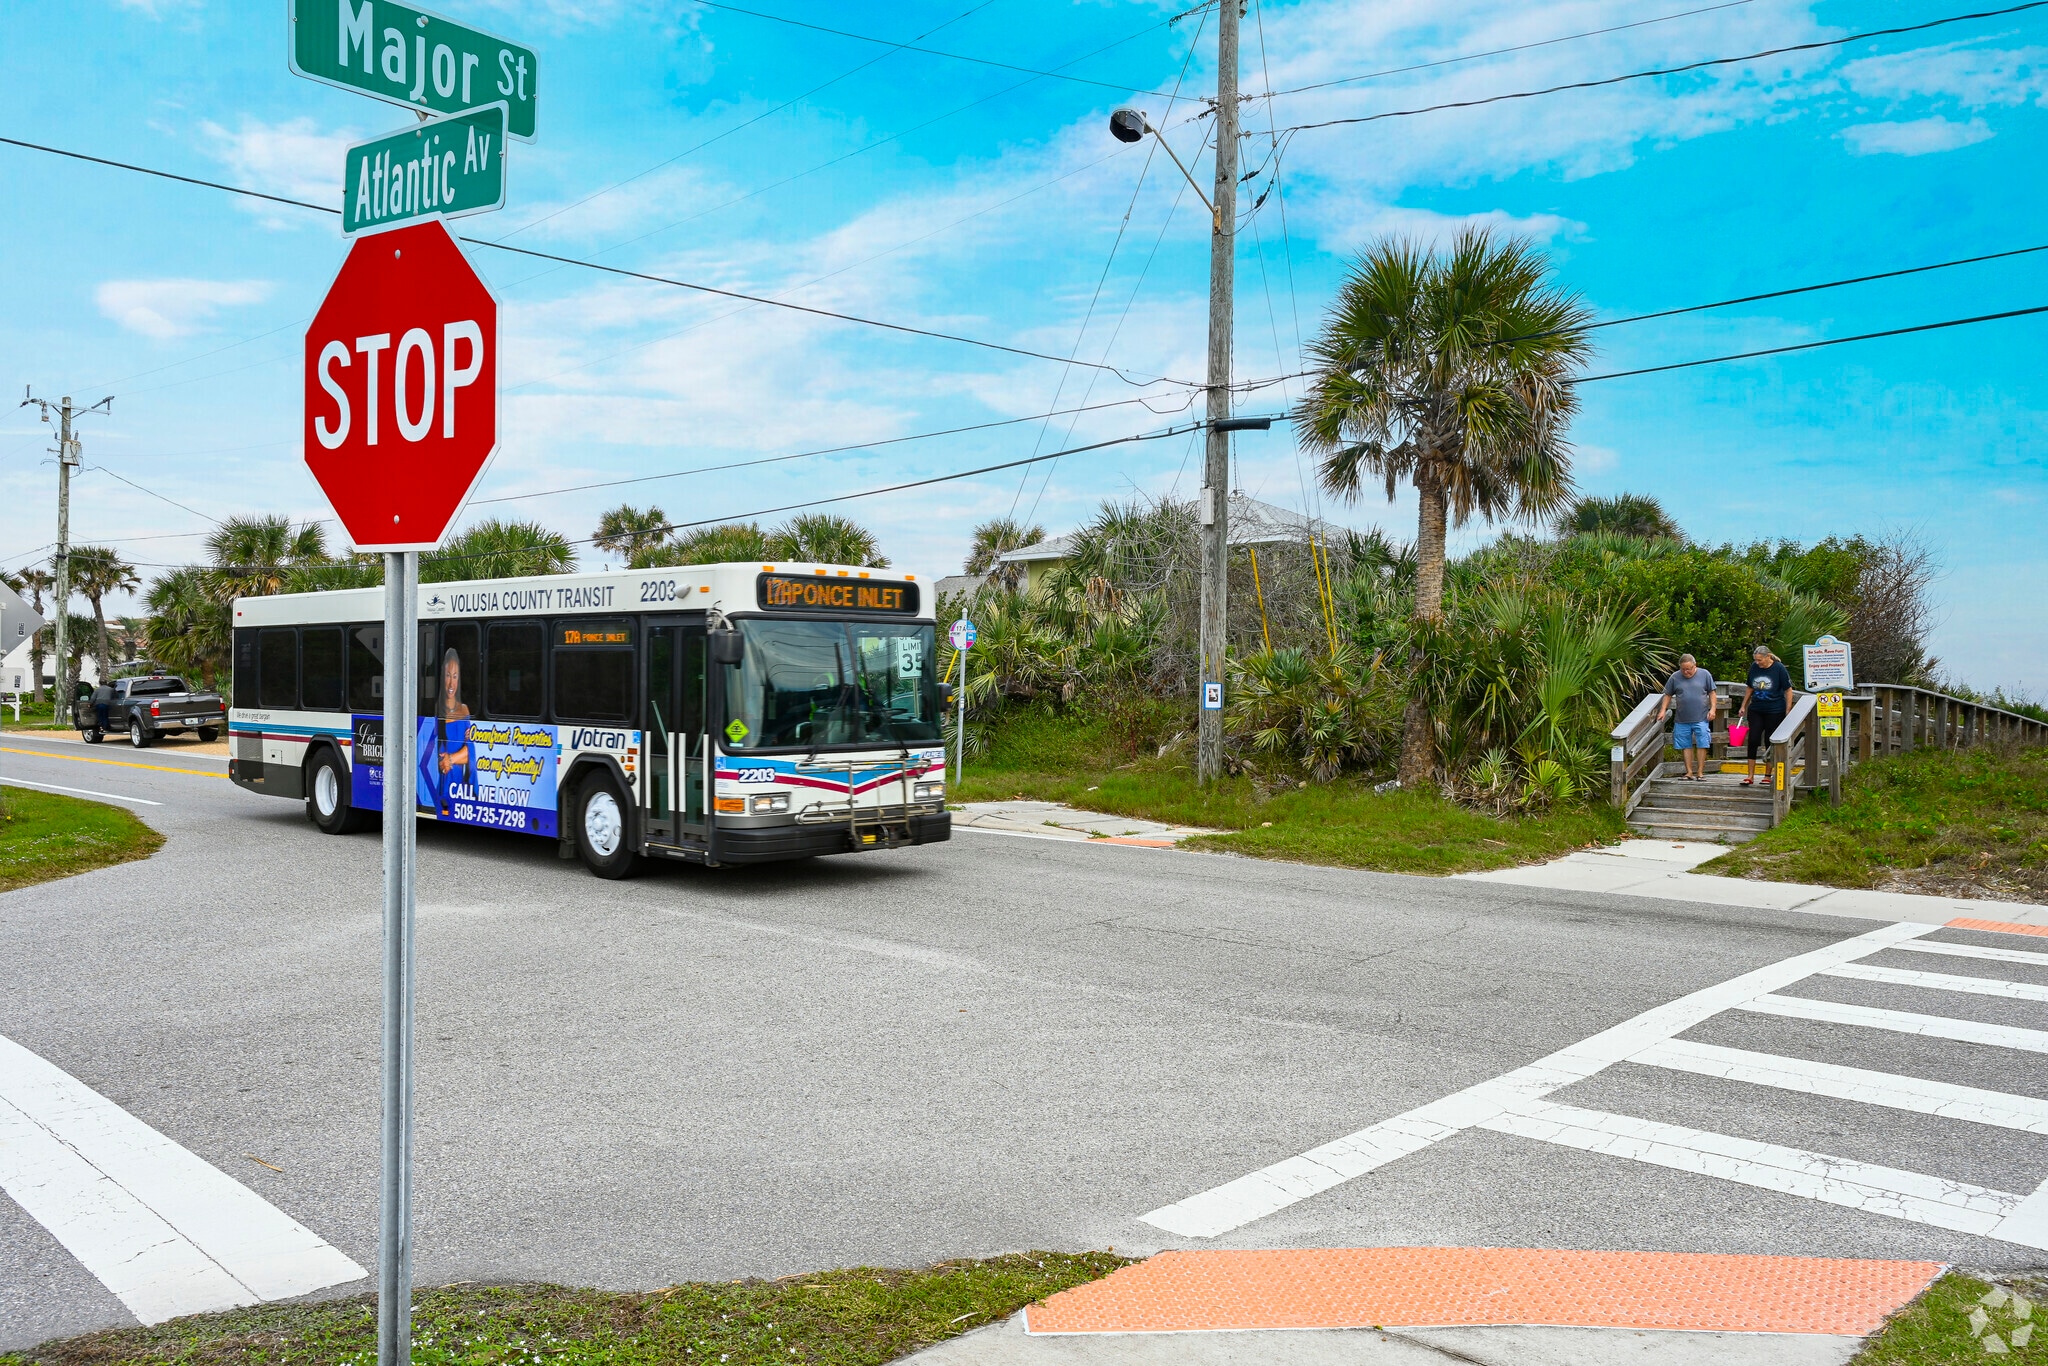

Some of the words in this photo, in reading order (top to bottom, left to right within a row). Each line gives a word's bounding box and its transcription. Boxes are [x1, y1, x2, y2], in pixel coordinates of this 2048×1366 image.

[338, 0, 479, 104] Major
[496, 48, 528, 102] St
[354, 134, 456, 223] Atlantic
[463, 125, 491, 175] Av
[314, 319, 484, 450] STOP
[450, 592, 499, 613] VOLUSIA
[502, 589, 553, 611] COUNTY
[557, 586, 615, 609] TRANSIT
[641, 580, 676, 602] 2203
[858, 586, 904, 609] INLET
[903, 642, 922, 651] LIMI
[469, 723, 511, 751] Oceanfront
[512, 726, 553, 752] Properties
[571, 728, 626, 750] Votran
[476, 756, 491, 772] are
[491, 758, 503, 781] my
[503, 754, 544, 785] Specialty!
[738, 767, 775, 784] 2203
[449, 782, 476, 801] CALL
[478, 785, 496, 803] ME
[499, 787, 530, 807] NOW
[453, 803, 526, 829] 508-735-7298
